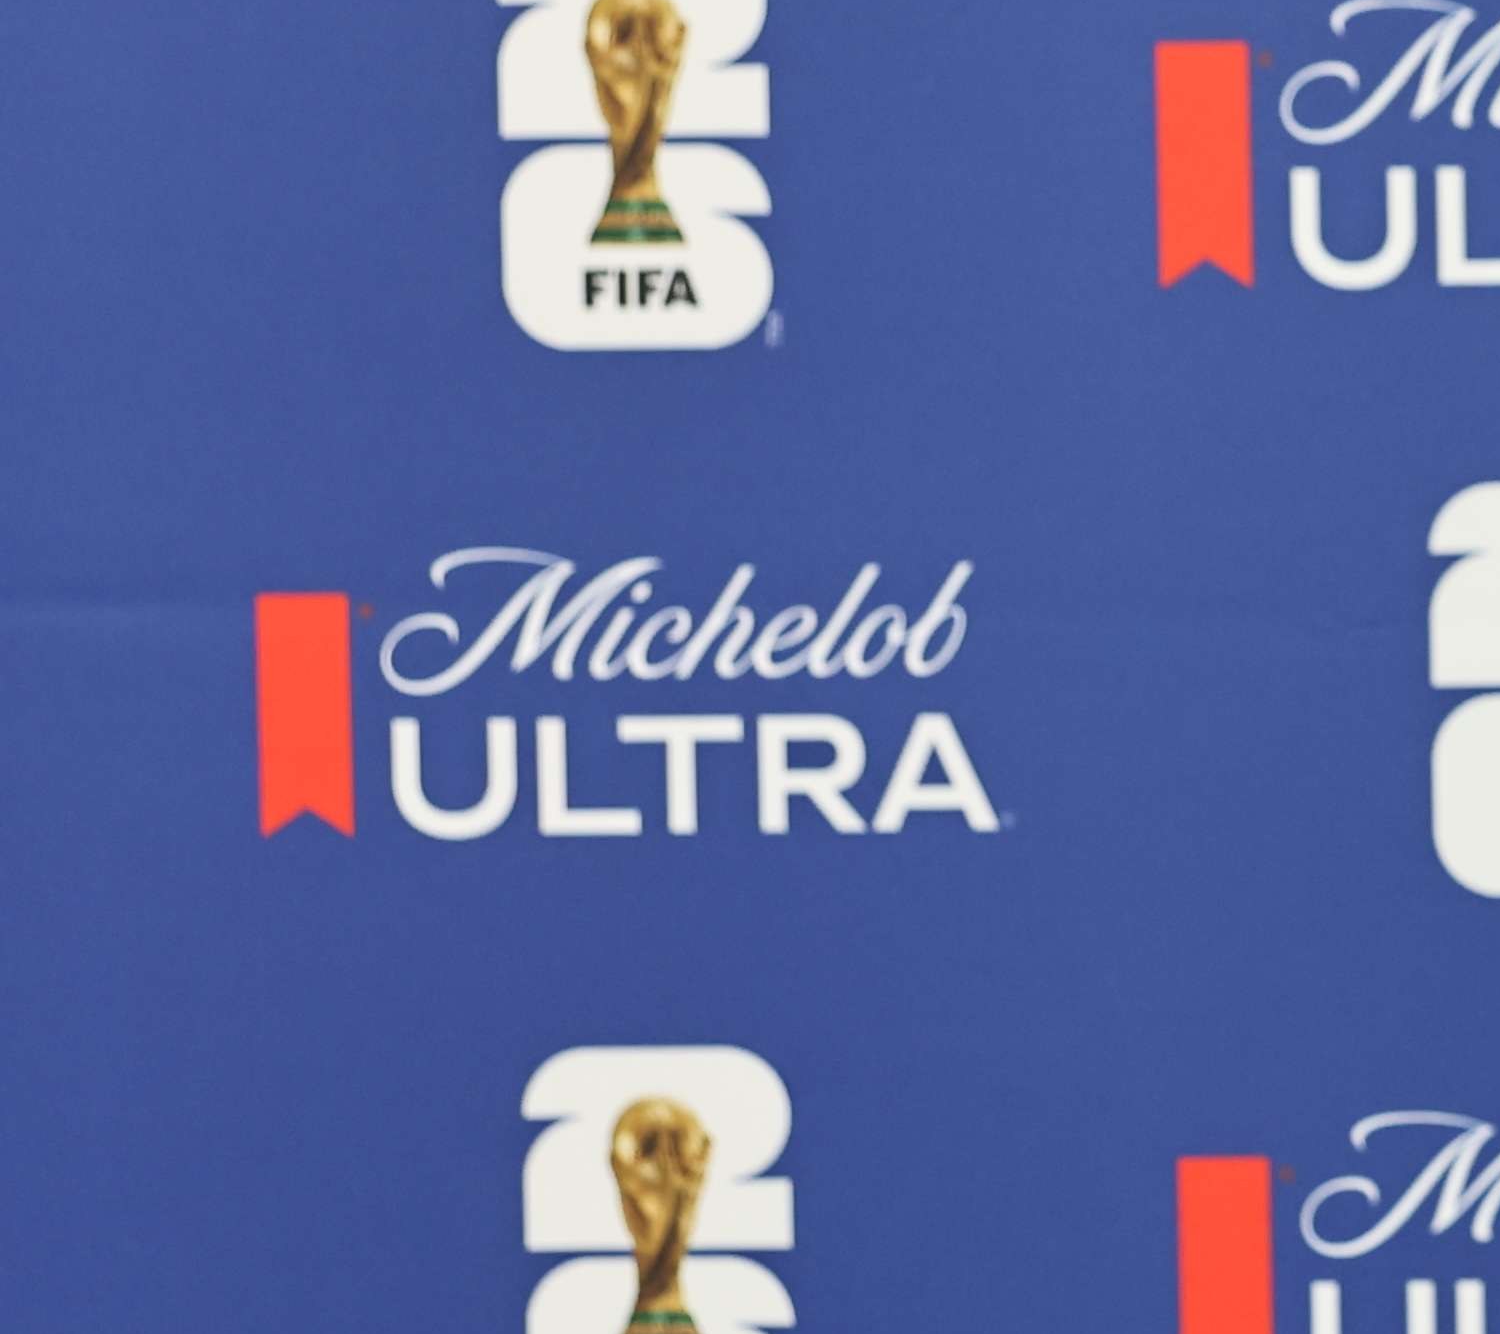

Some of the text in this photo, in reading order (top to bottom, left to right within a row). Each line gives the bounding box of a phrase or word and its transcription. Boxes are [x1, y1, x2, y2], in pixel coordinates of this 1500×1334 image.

[584, 269, 698, 308] FIFA
[380, 547, 972, 695] Michelob
[390, 713, 999, 840] ULTRA
